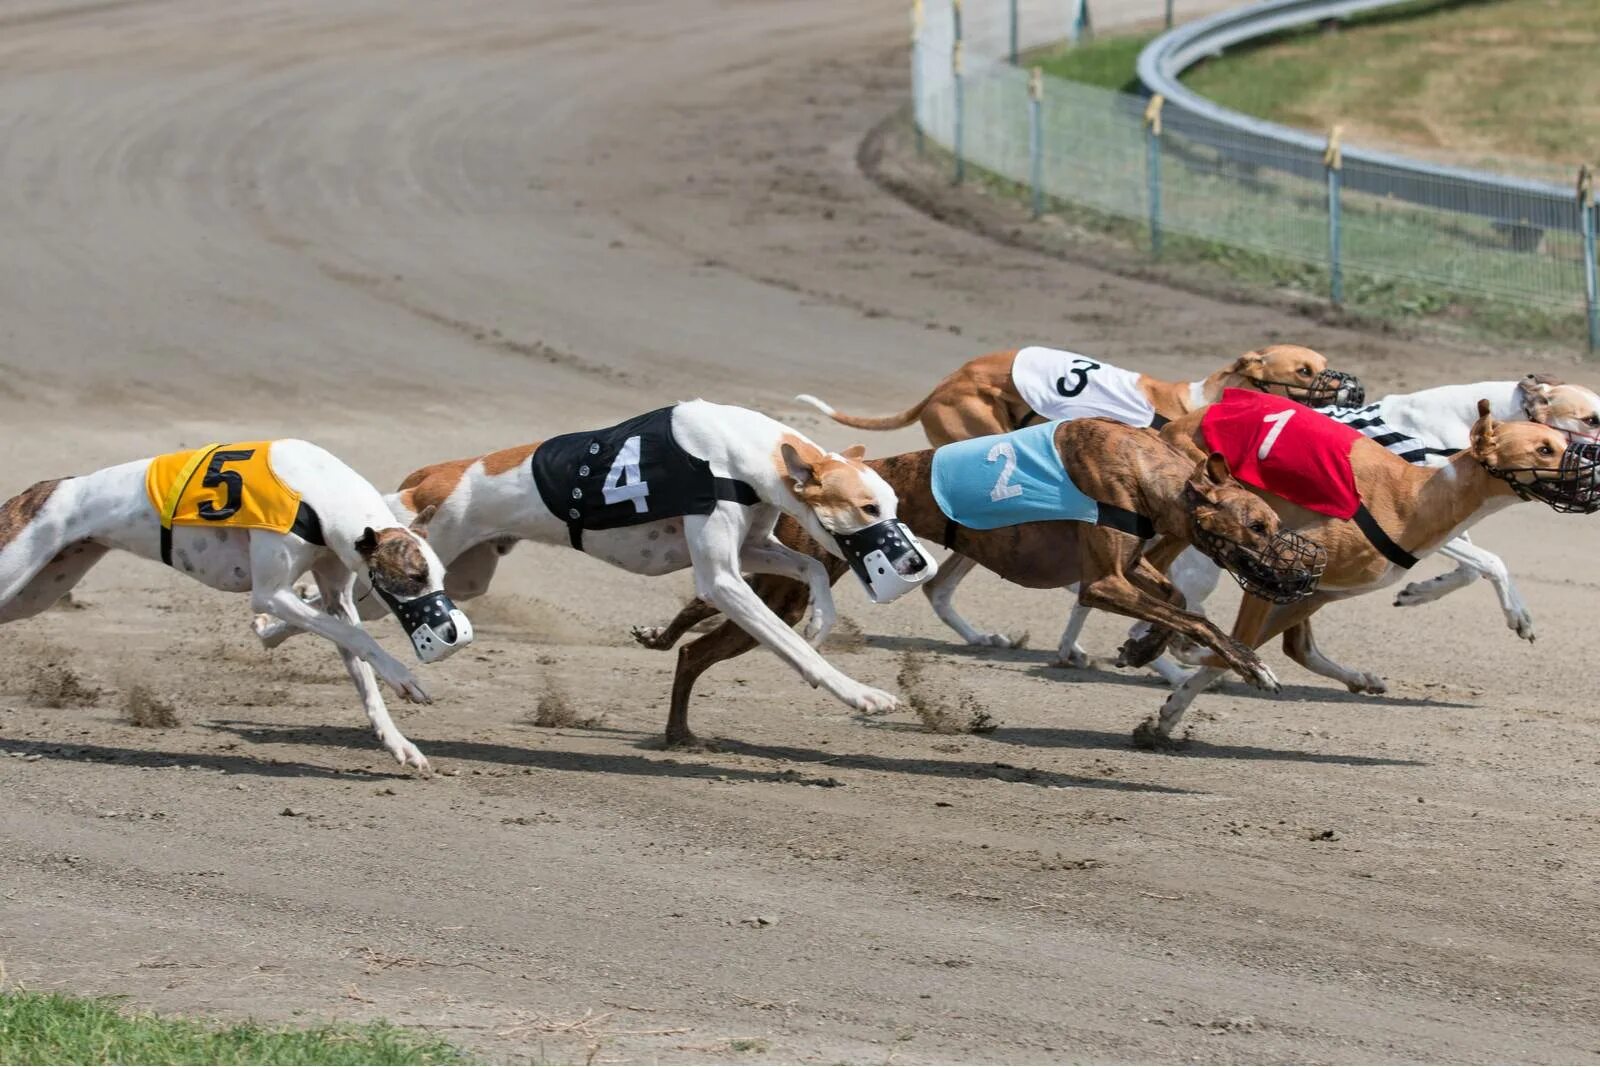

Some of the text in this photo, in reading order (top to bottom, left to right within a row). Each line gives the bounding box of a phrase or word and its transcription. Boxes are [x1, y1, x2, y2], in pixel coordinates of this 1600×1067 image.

[1057, 359, 1101, 398] 3
[1257, 408, 1296, 460] 1
[198, 449, 256, 521] 5
[602, 435, 650, 513] 4
[987, 442, 1023, 503] 2
